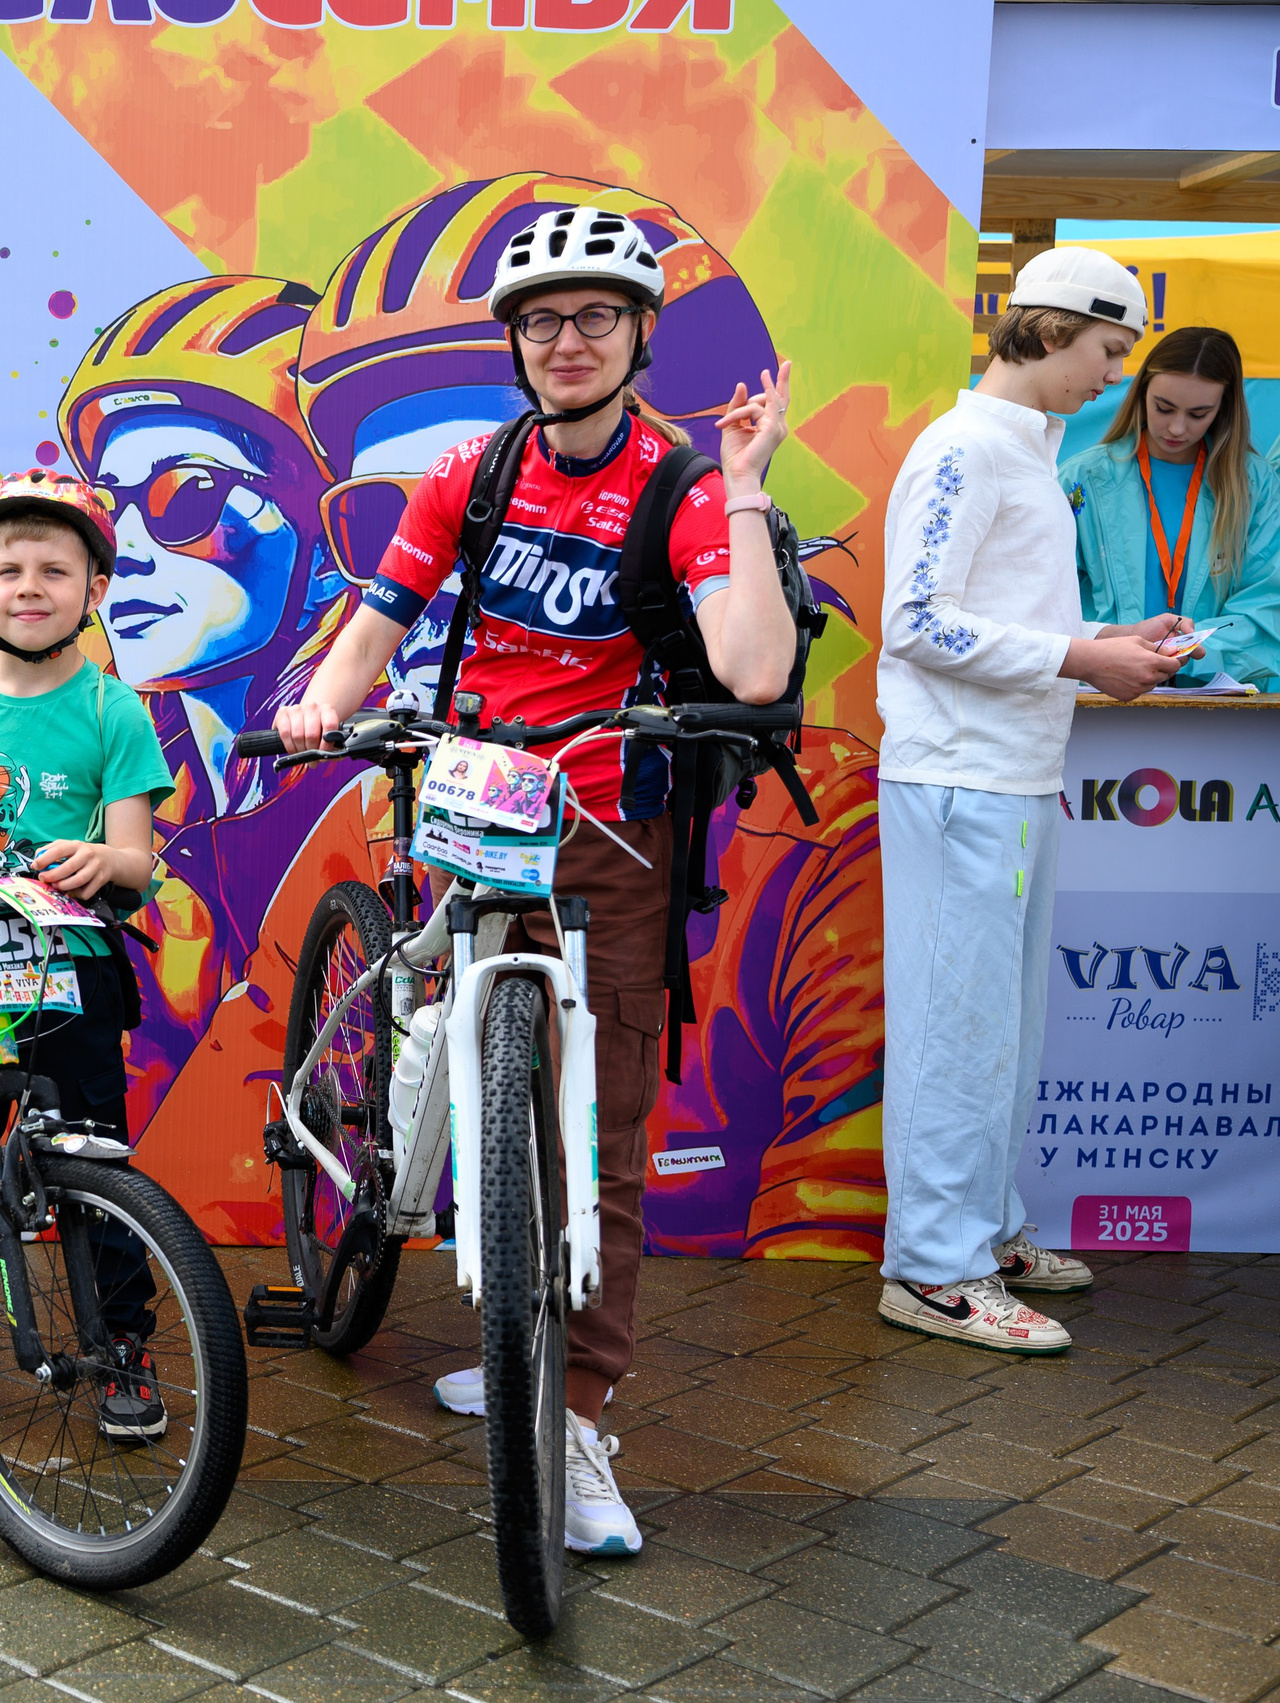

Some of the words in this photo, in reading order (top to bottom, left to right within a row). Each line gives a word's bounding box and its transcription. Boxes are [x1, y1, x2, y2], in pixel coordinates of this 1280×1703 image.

[428, 780, 476, 801] 00678
[1081, 767, 1234, 827] KOLA
[24, 907, 58, 917] 0679
[1056, 941, 1243, 992] VIVA
[15, 978, 39, 988] VIVA
[1106, 997, 1185, 1038] Ровар
[1037, 1081, 1272, 1107] ІЖНАРОДНЫ
[1026, 1113, 1280, 1138] ЛАКАРНАВАЛ
[1040, 1146, 1059, 1168] У
[1076, 1147, 1219, 1170] МІНСКУ
[1099, 1205, 1118, 1220] 31
[1125, 1205, 1162, 1220] МАЯ
[1098, 1221, 1168, 1242] 2025
